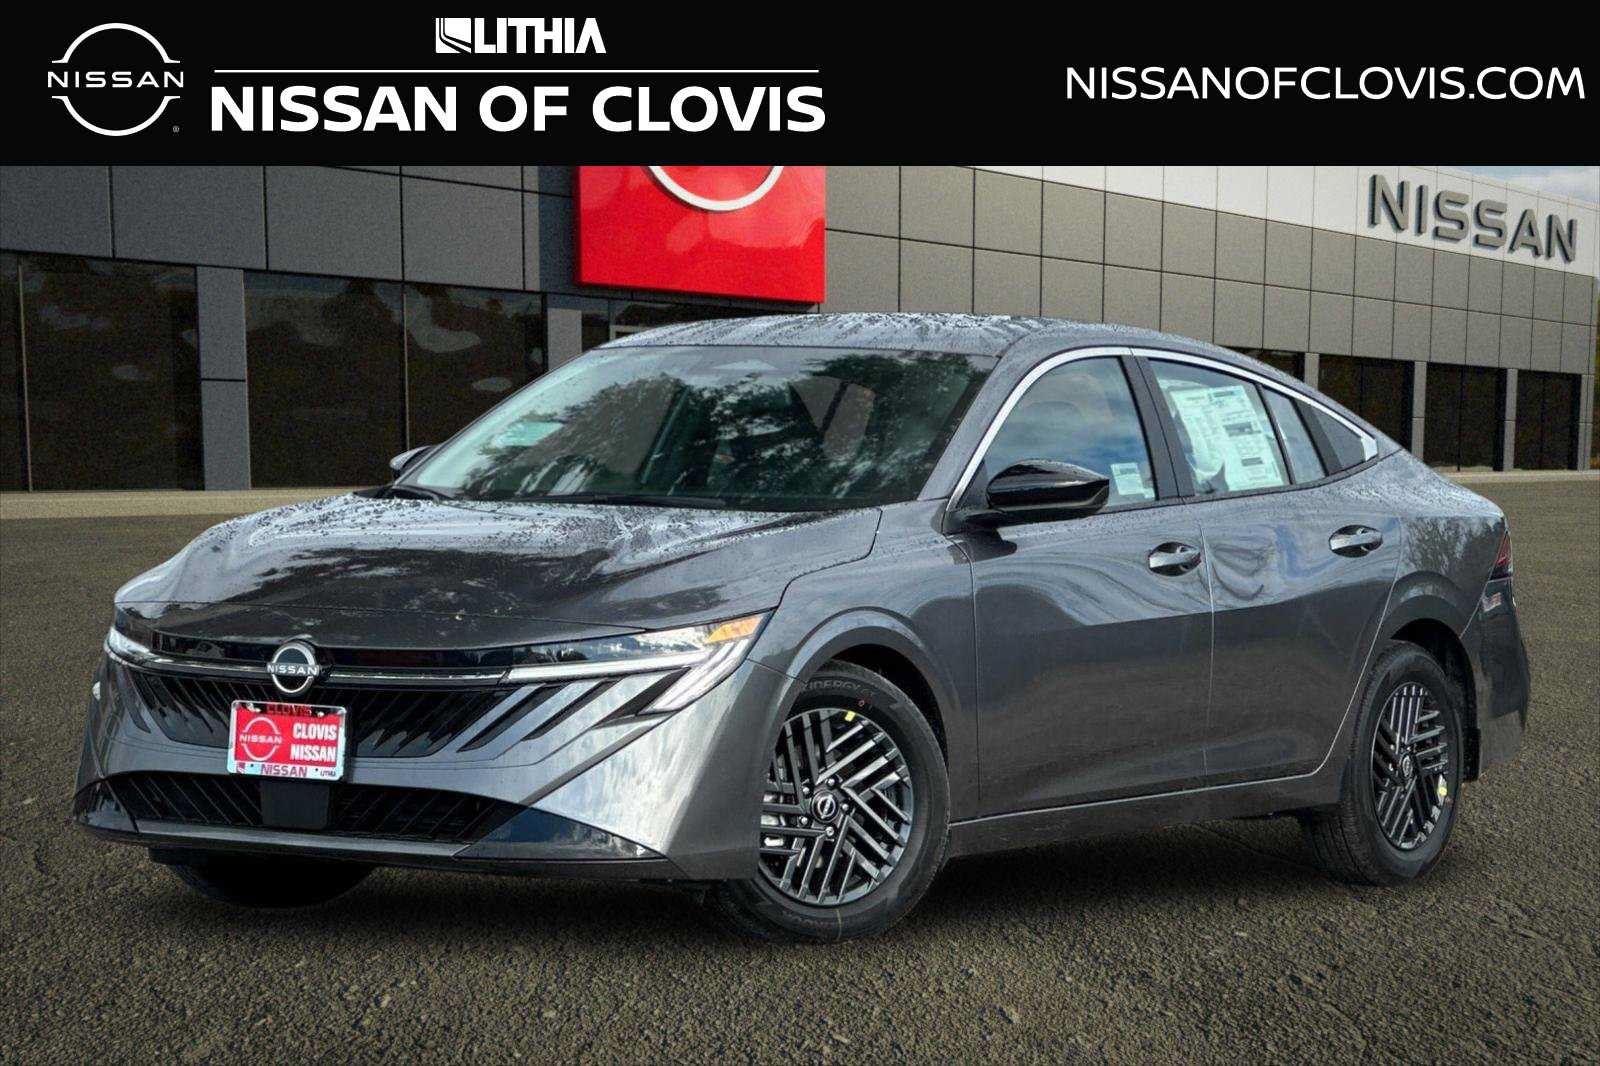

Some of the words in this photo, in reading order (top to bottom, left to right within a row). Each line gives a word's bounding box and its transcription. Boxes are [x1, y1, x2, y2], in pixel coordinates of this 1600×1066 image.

[1369, 174, 1577, 264] NISSAN
[267, 663, 320, 676] NISSAN
[239, 734, 283, 744] NISSAN
[293, 722, 337, 741] CLOVIS
[290, 744, 336, 762] NISSAN
[261, 763, 308, 777] NISSAN
